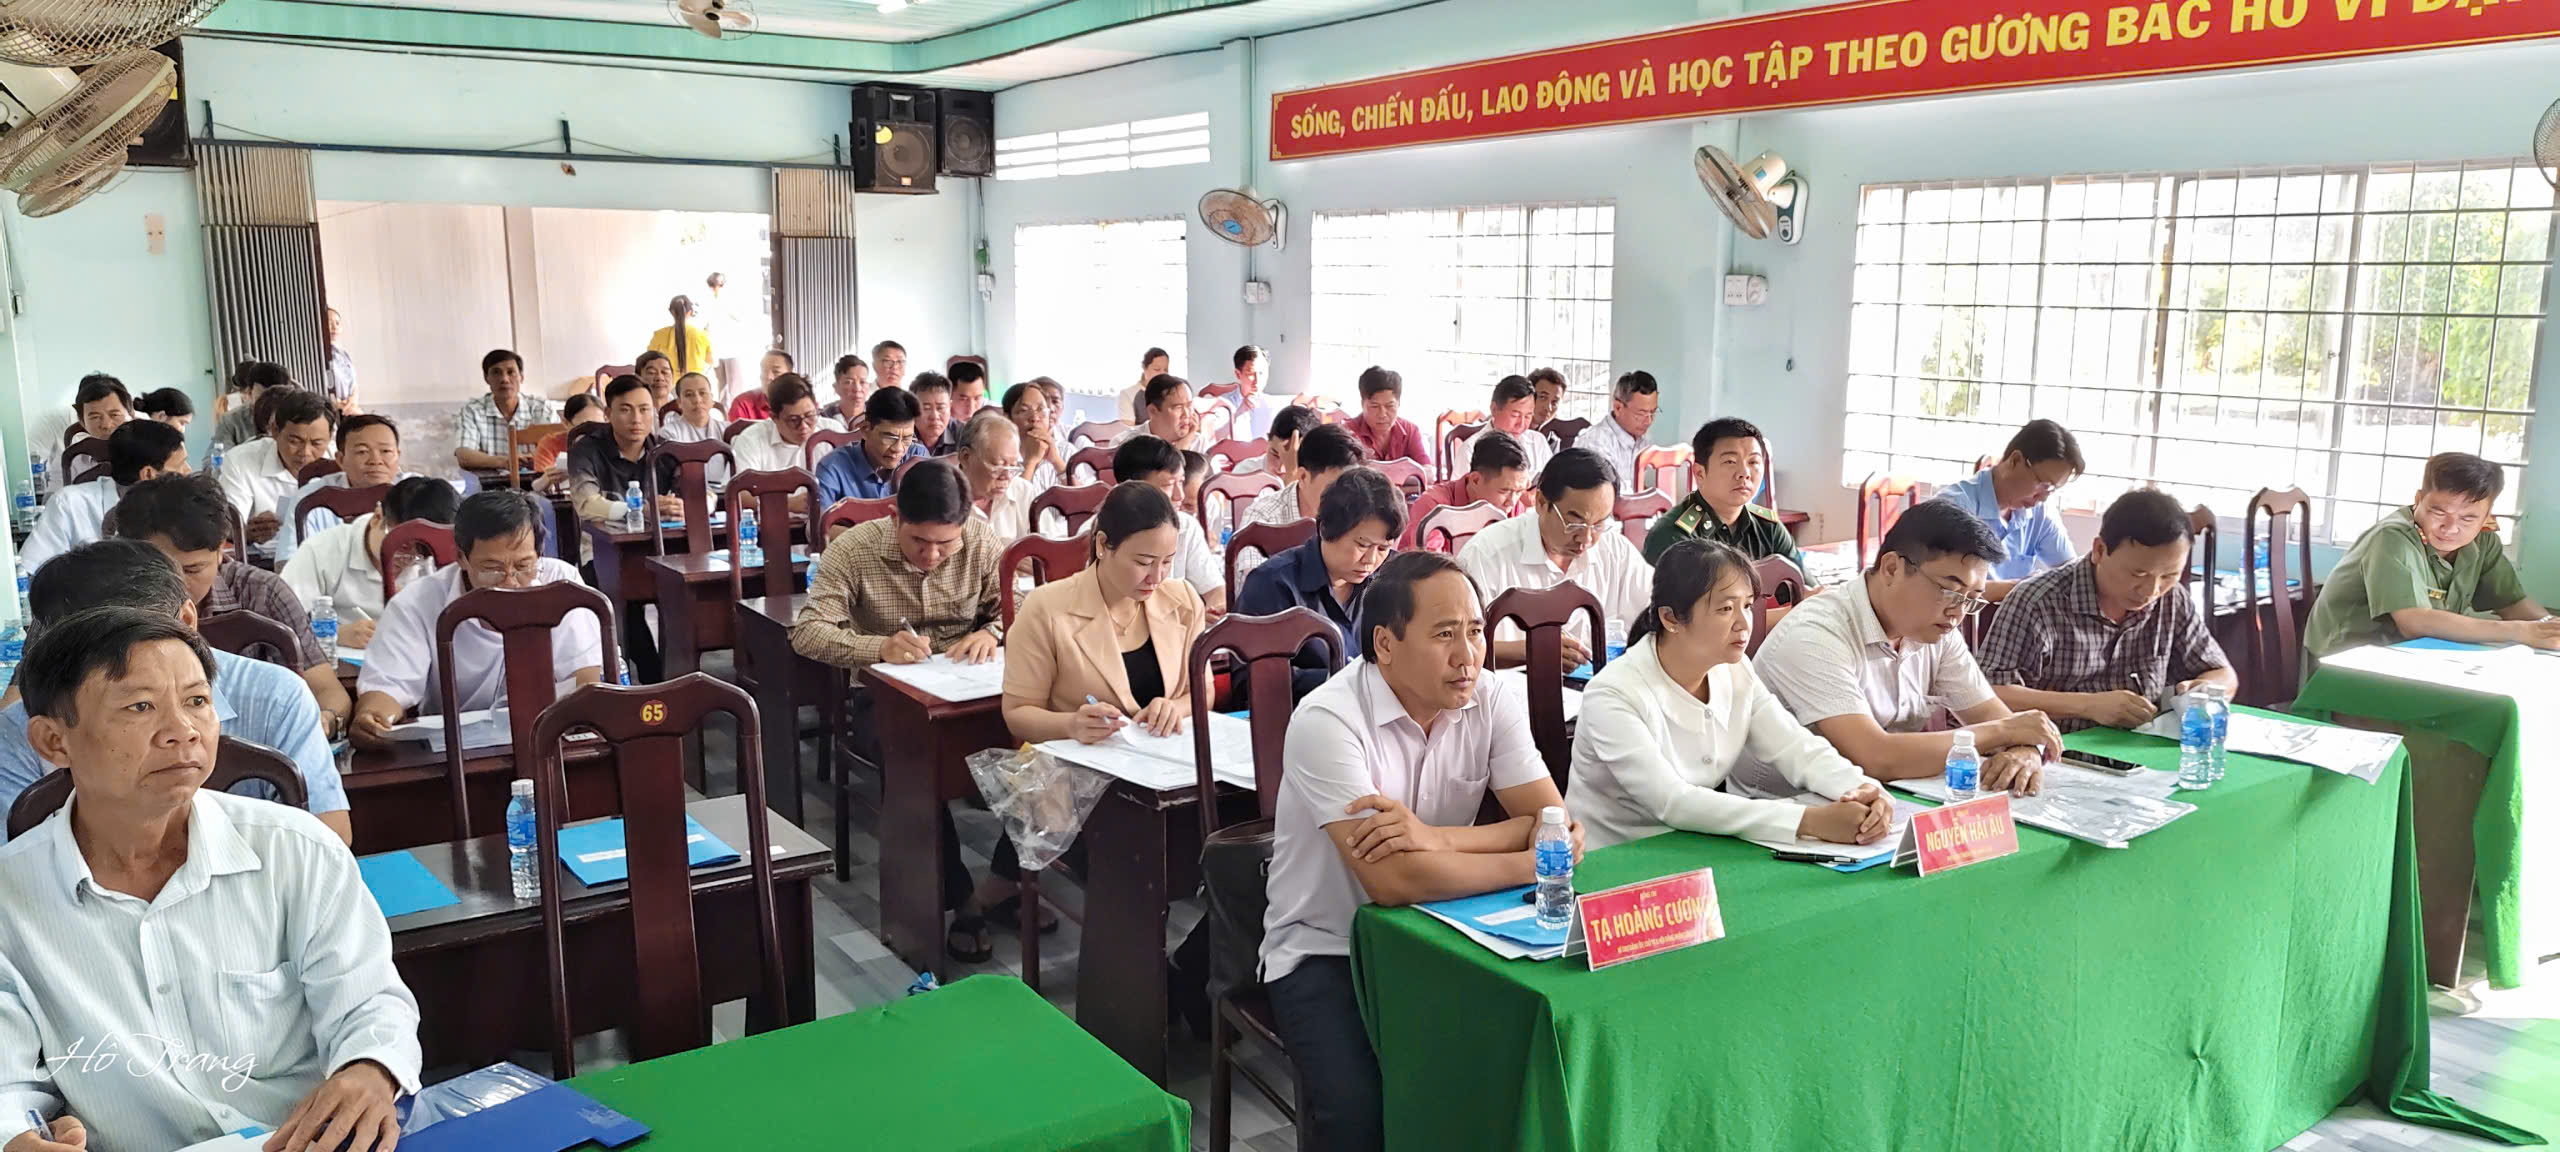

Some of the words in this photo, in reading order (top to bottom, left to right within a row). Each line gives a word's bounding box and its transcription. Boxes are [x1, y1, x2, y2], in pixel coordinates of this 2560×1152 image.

[1291, 104, 1345, 139] SỐNG,
[1352, 91, 1414, 132] CHIẾN
[1421, 83, 1473, 123] ĐẤU,
[1481, 84, 1528, 116] LAO
[1536, 70, 1610, 112] ĐỘNG
[1619, 58, 1656, 99] VÀ
[1668, 55, 1733, 97] HỌC
[1744, 40, 1813, 89] TẬP
[1824, 31, 1927, 76] THEO
[1941, 12, 2091, 64] GƯƠNG
[642, 704, 664, 722] 65
[1925, 817, 1969, 852] NGUYỄN
[1590, 917, 1613, 946] TẠ
[1613, 904, 1665, 938] HOÀNG
